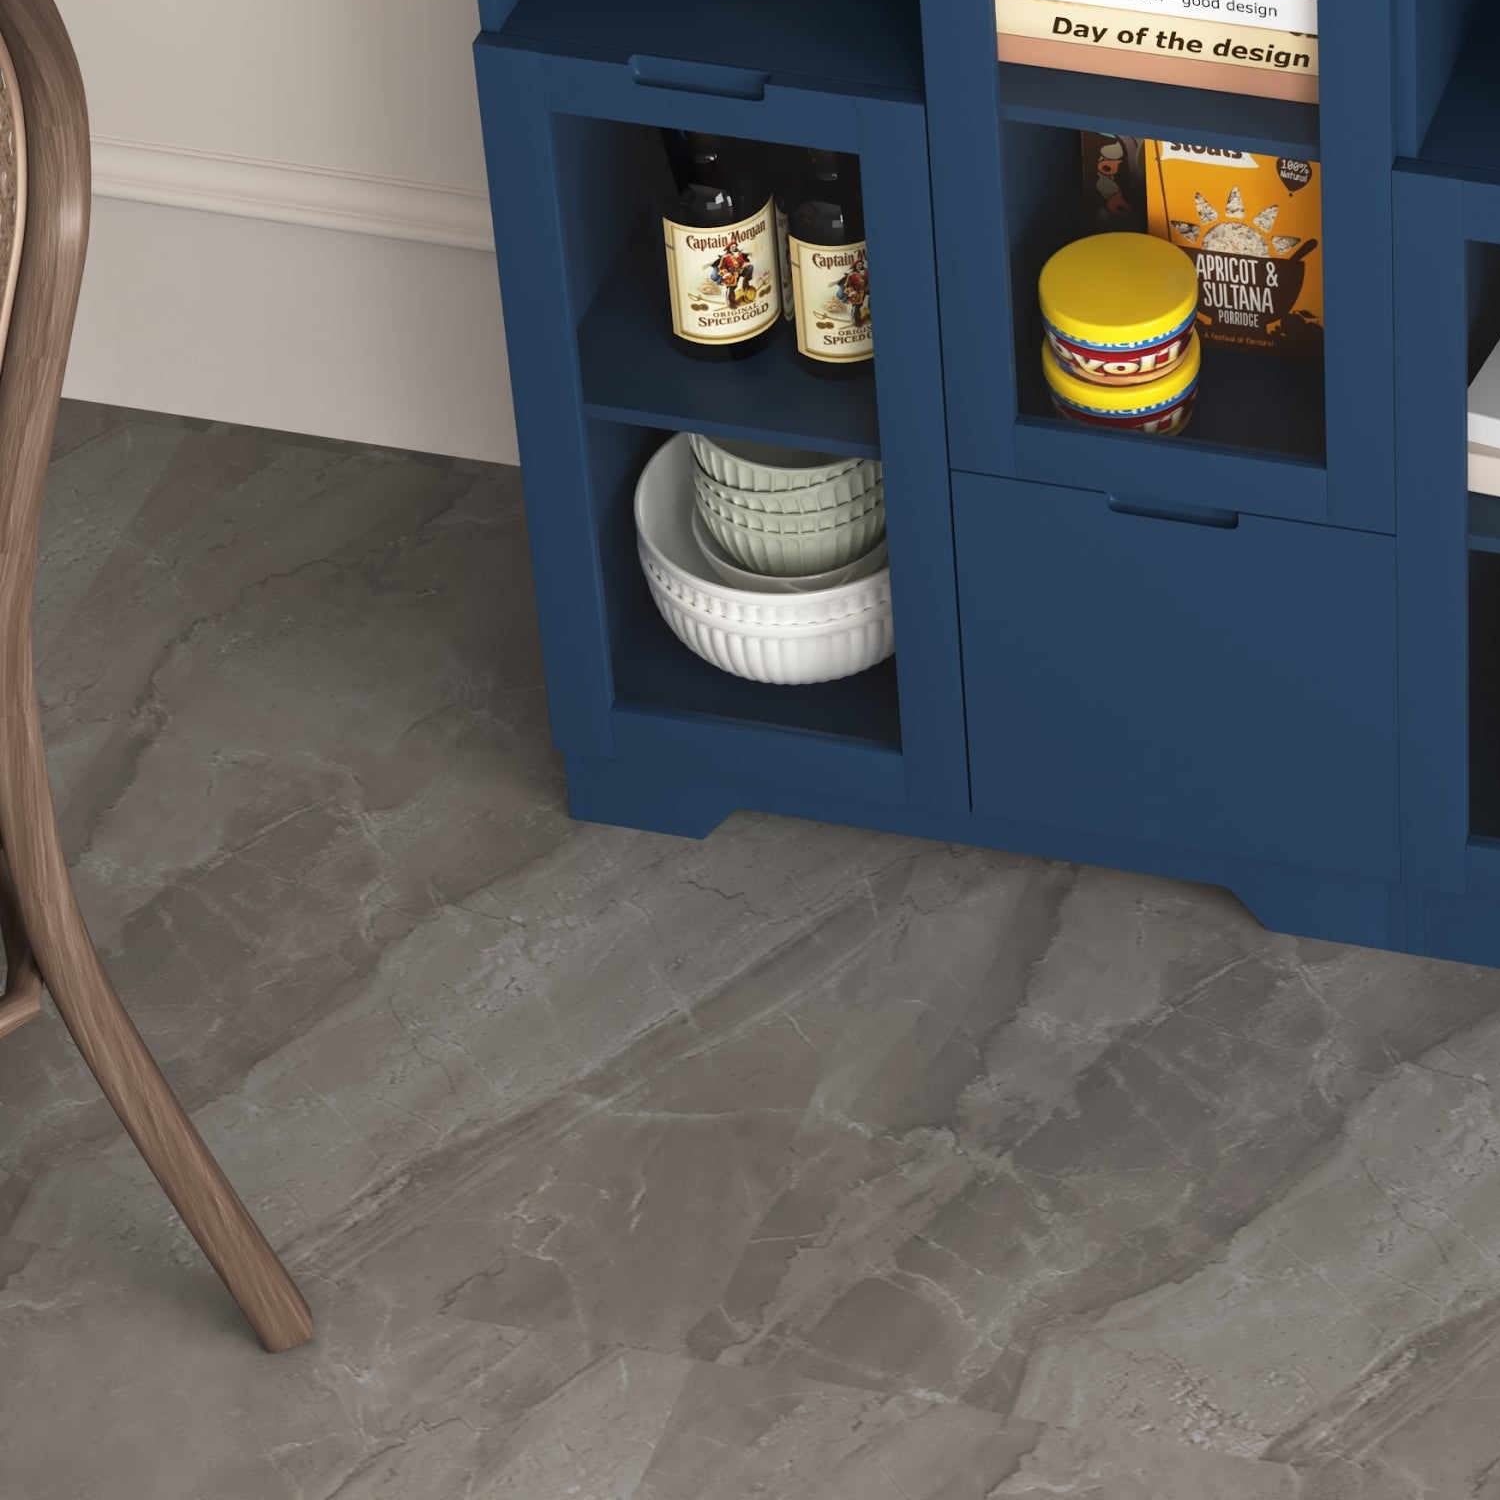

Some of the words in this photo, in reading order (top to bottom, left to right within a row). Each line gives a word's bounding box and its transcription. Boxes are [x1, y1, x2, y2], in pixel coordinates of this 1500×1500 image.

[1052, 16, 1108, 43] Day
[1117, 26, 1149, 46] of
[1155, 31, 1203, 54] the
[1213, 37, 1310, 69] design
[1280, 158, 1310, 174] 100%
[1280, 170, 1308, 183] Natural
[686, 234, 728, 252] Captain
[728, 220, 766, 243] Morgan
[812, 252, 855, 270] Captain
[1196, 254, 1258, 285] APRICOT
[1266, 261, 1279, 287] &
[1203, 281, 1274, 314] SULTANA
[698, 315, 740, 327] SPICED
[741, 302, 769, 321] GOLD
[713, 303, 758, 318] ORIGINAL
[1218, 309, 1259, 328] PORRIDGE
[823, 333, 866, 345] SPICED
